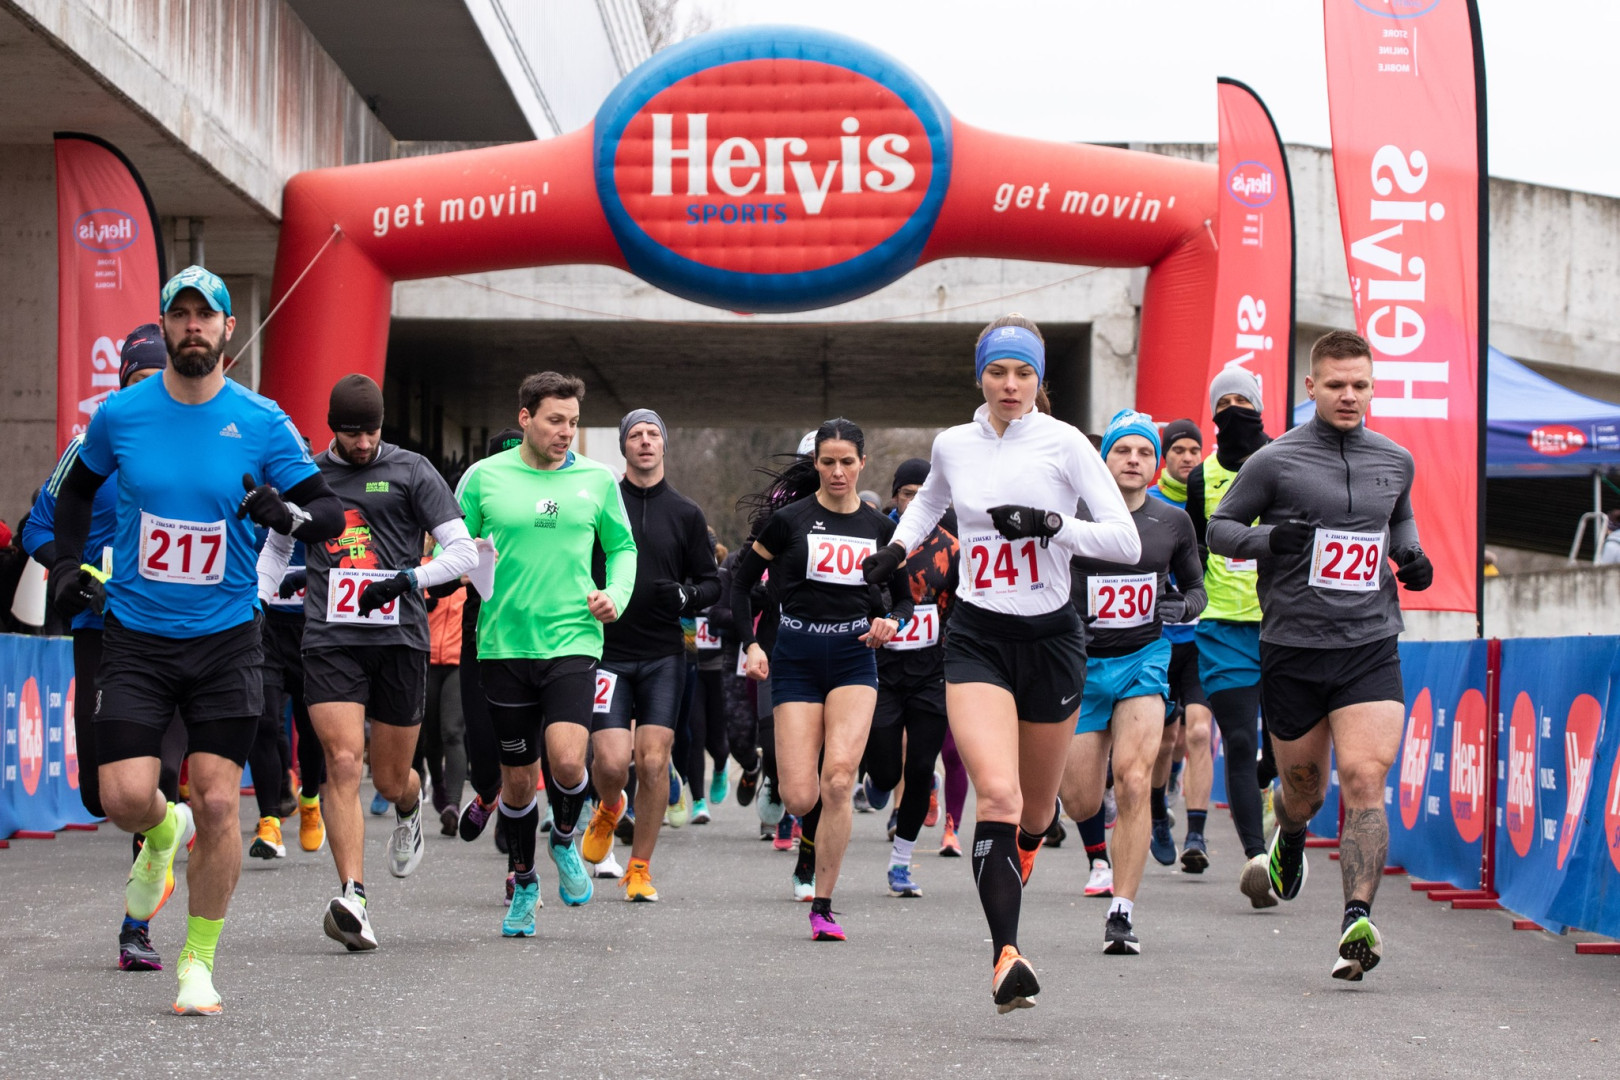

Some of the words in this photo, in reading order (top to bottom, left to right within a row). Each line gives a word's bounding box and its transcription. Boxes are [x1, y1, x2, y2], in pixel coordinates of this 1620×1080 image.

[650, 113, 916, 215] Hervis
[372, 198, 425, 237] get
[439, 181, 550, 224] movin'
[686, 203, 788, 225] SPORTS
[992, 182, 1051, 213] get
[1061, 188, 1176, 223] movin'
[344, 526, 370, 536] FIN
[147, 529, 222, 575] 217
[349, 544, 367, 559] ER
[817, 542, 871, 575] 204
[971, 540, 1039, 589] 241
[1321, 541, 1379, 581] 229
[1098, 583, 1153, 619] 230
[808, 622, 850, 634] NIKE
[852, 616, 869, 631] PR
[890, 613, 932, 642] 21
[1451, 720, 1484, 813] Hervi
[1506, 726, 1534, 825] Hervis
